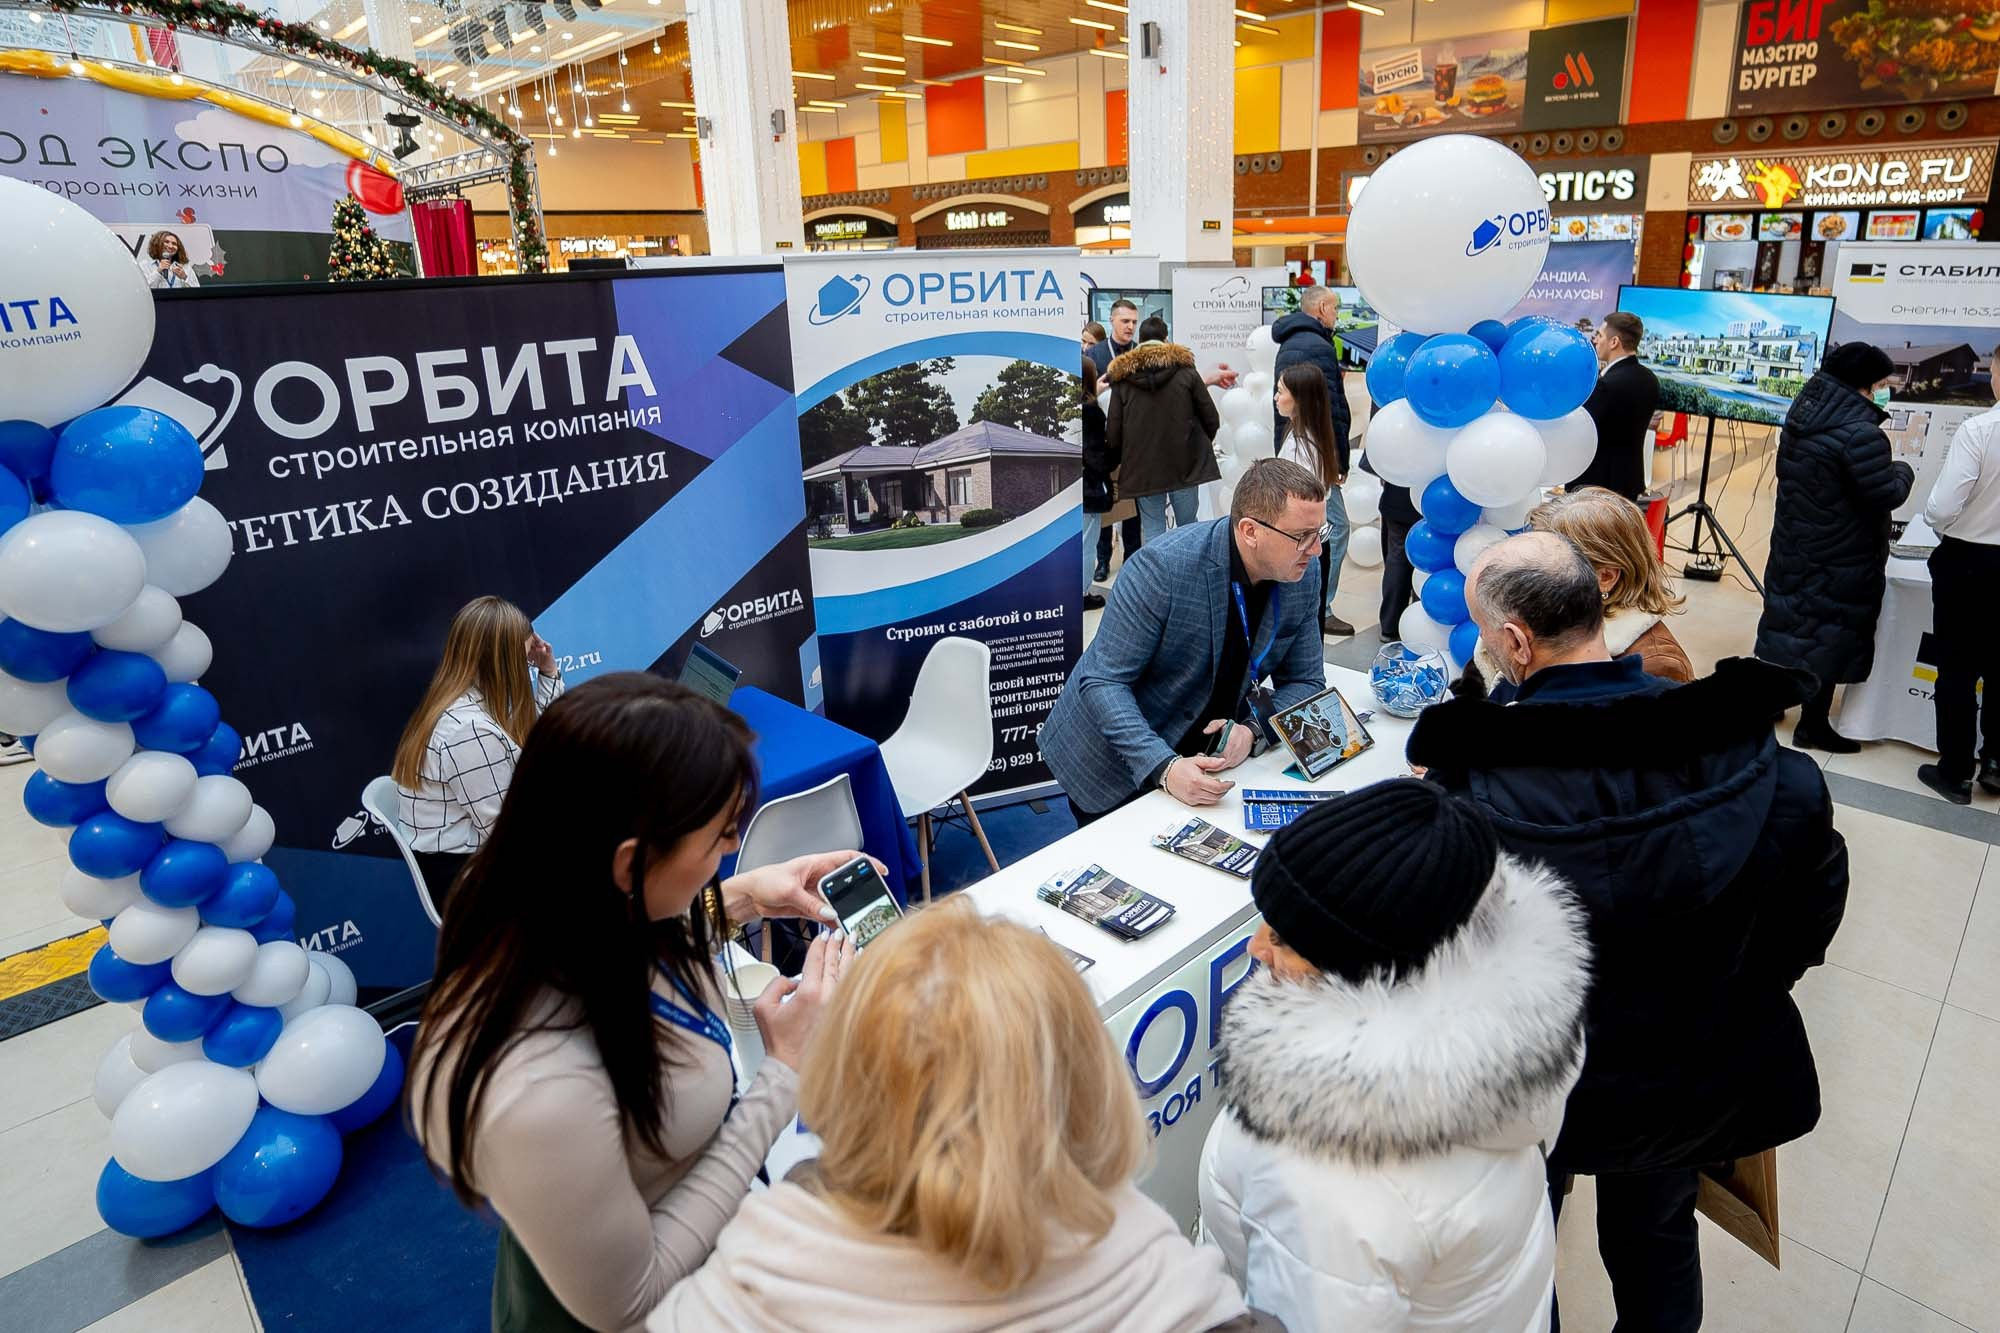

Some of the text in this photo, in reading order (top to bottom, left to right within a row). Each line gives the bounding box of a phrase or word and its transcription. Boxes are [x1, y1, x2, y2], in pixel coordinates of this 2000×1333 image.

[1742, 41, 1818, 66] МАЭСТРО
[1377, 64, 1419, 85] ВКУСНО
[1739, 63, 1817, 91] БУРГЕР
[98, 136, 289, 174] ЭКСПО
[1805, 157, 1973, 189] KONG FU
[1804, 188, 1966, 207] КИТАЙСКИЙ ФУД-КОРТ
[1899, 265, 2000, 278] СТАБИЛ
[882, 269, 1064, 307] ОРБИТА
[1521, 288, 1604, 300] АУНХАУСЫ
[885, 306, 1065, 326] строительная компания
[0, 330, 82, 350] компания
[253, 334, 658, 440] ОРБИТА
[268, 405, 663, 480] строительная компания
[421, 450, 669, 520] СОЗИДАНИЯ
[727, 588, 804, 622] ОРБИТА
[728, 612, 774, 631] строительная
[886, 604, 1064, 642] Строим с заботой о вас!
[1015, 637, 1064, 651] архитекторы
[1026, 629, 1064, 641] технадзор
[1032, 646, 1064, 657] бригады
[1038, 653, 1065, 665] подход
[989, 672, 1065, 692] СВОЕЙ МЕЧТЫ
[261, 741, 314, 763] компания
[1009, 752, 1033, 767] 929
